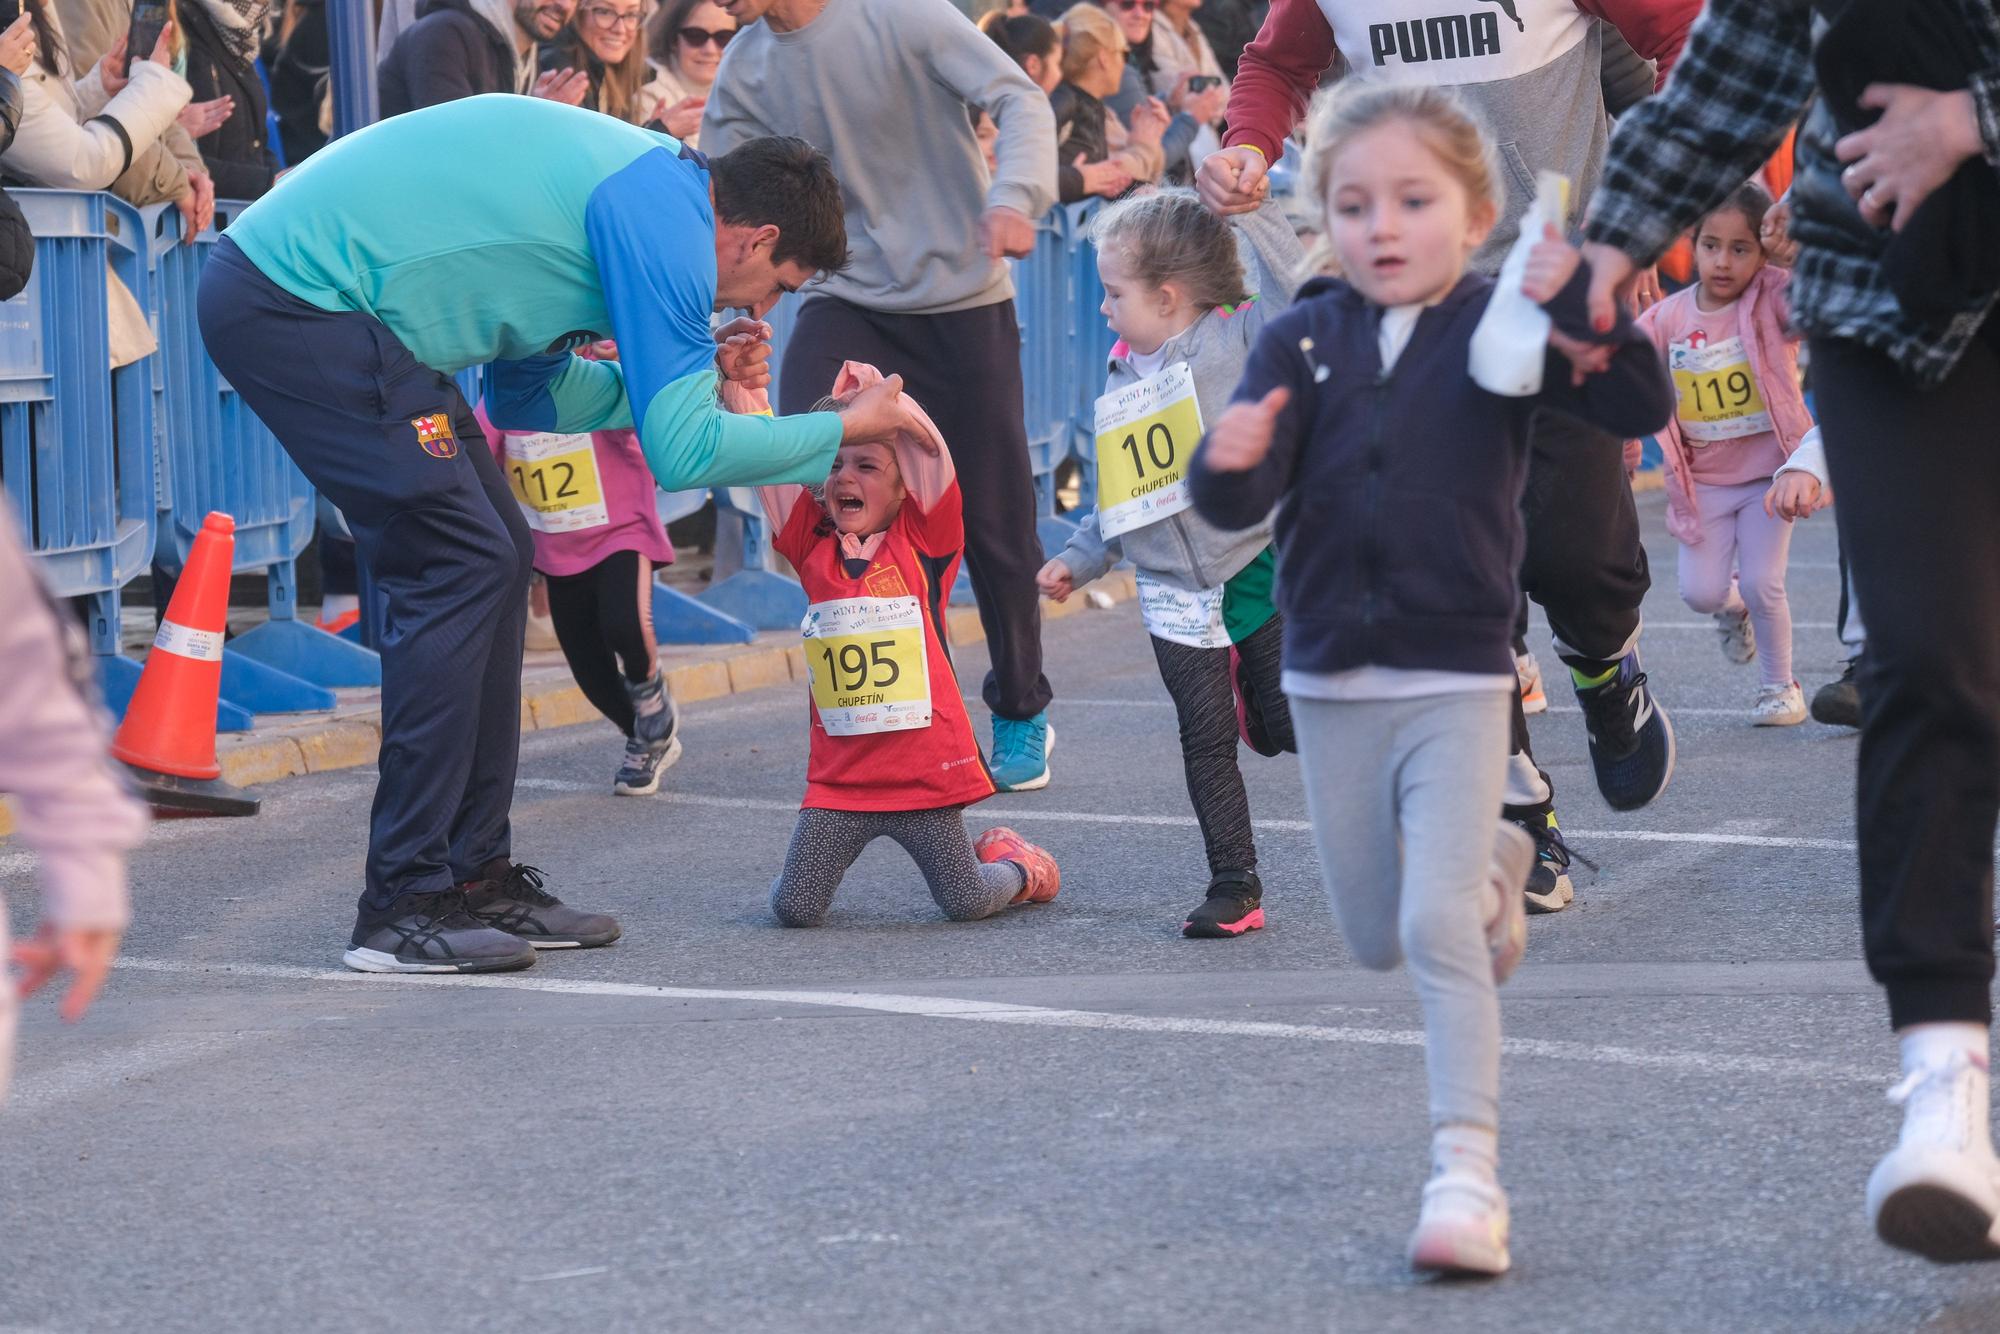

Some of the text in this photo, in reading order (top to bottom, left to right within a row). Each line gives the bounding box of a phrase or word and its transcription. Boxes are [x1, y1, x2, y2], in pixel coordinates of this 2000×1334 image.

[1369, 11, 1500, 66] PUMA
[1119, 389, 1140, 408] MINI
[1691, 371, 1752, 412] 119
[1122, 423, 1175, 479] 10
[513, 462, 579, 502] 112
[1131, 471, 1179, 498] CHUPETÍN
[832, 605, 856, 620] MINI
[823, 640, 899, 692] 195
[838, 692, 884, 708] CHUPETÍN
